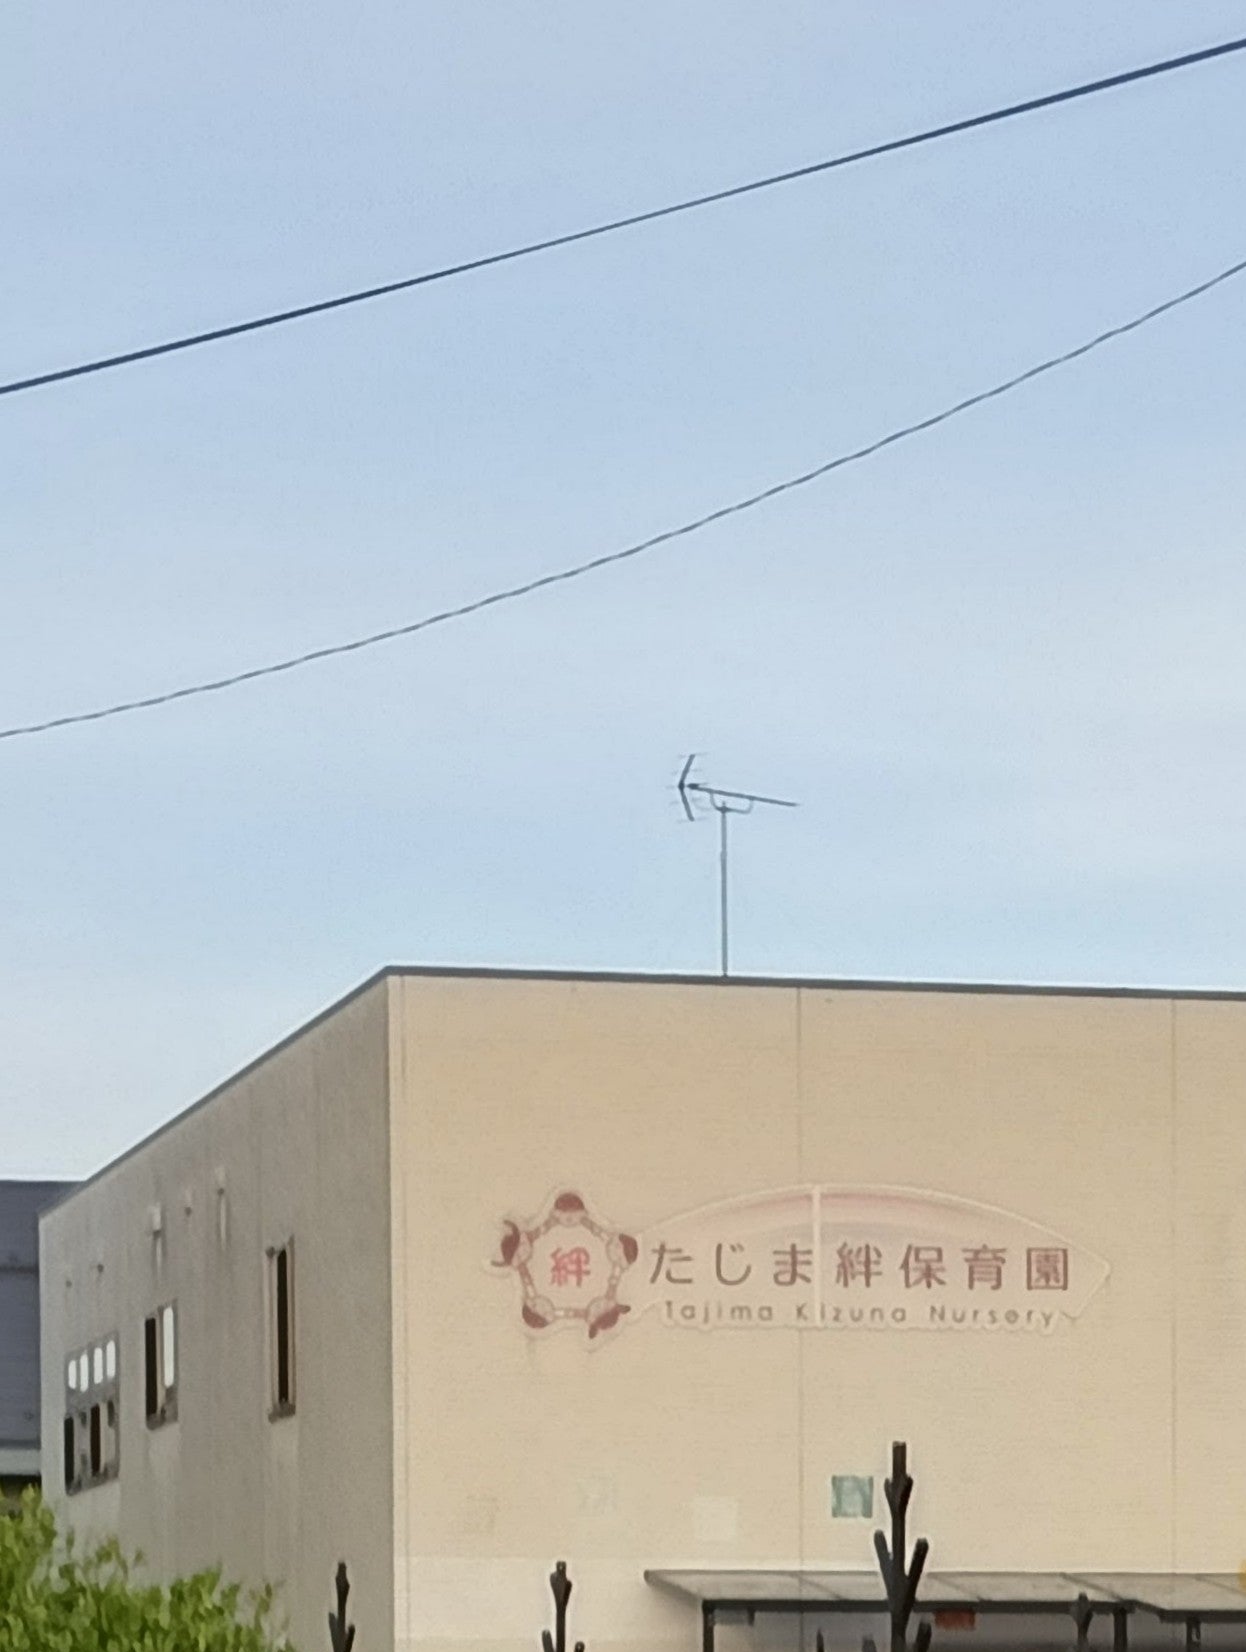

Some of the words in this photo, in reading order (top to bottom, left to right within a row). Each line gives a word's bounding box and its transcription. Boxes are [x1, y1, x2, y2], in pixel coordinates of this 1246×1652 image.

[551, 1247, 591, 1288] 絆
[649, 1241, 1069, 1291] たじま絆保育園
[666, 1301, 773, 1325] Tajima
[796, 1303, 907, 1324] Kizuna
[929, 1304, 1053, 1328] Nursery
